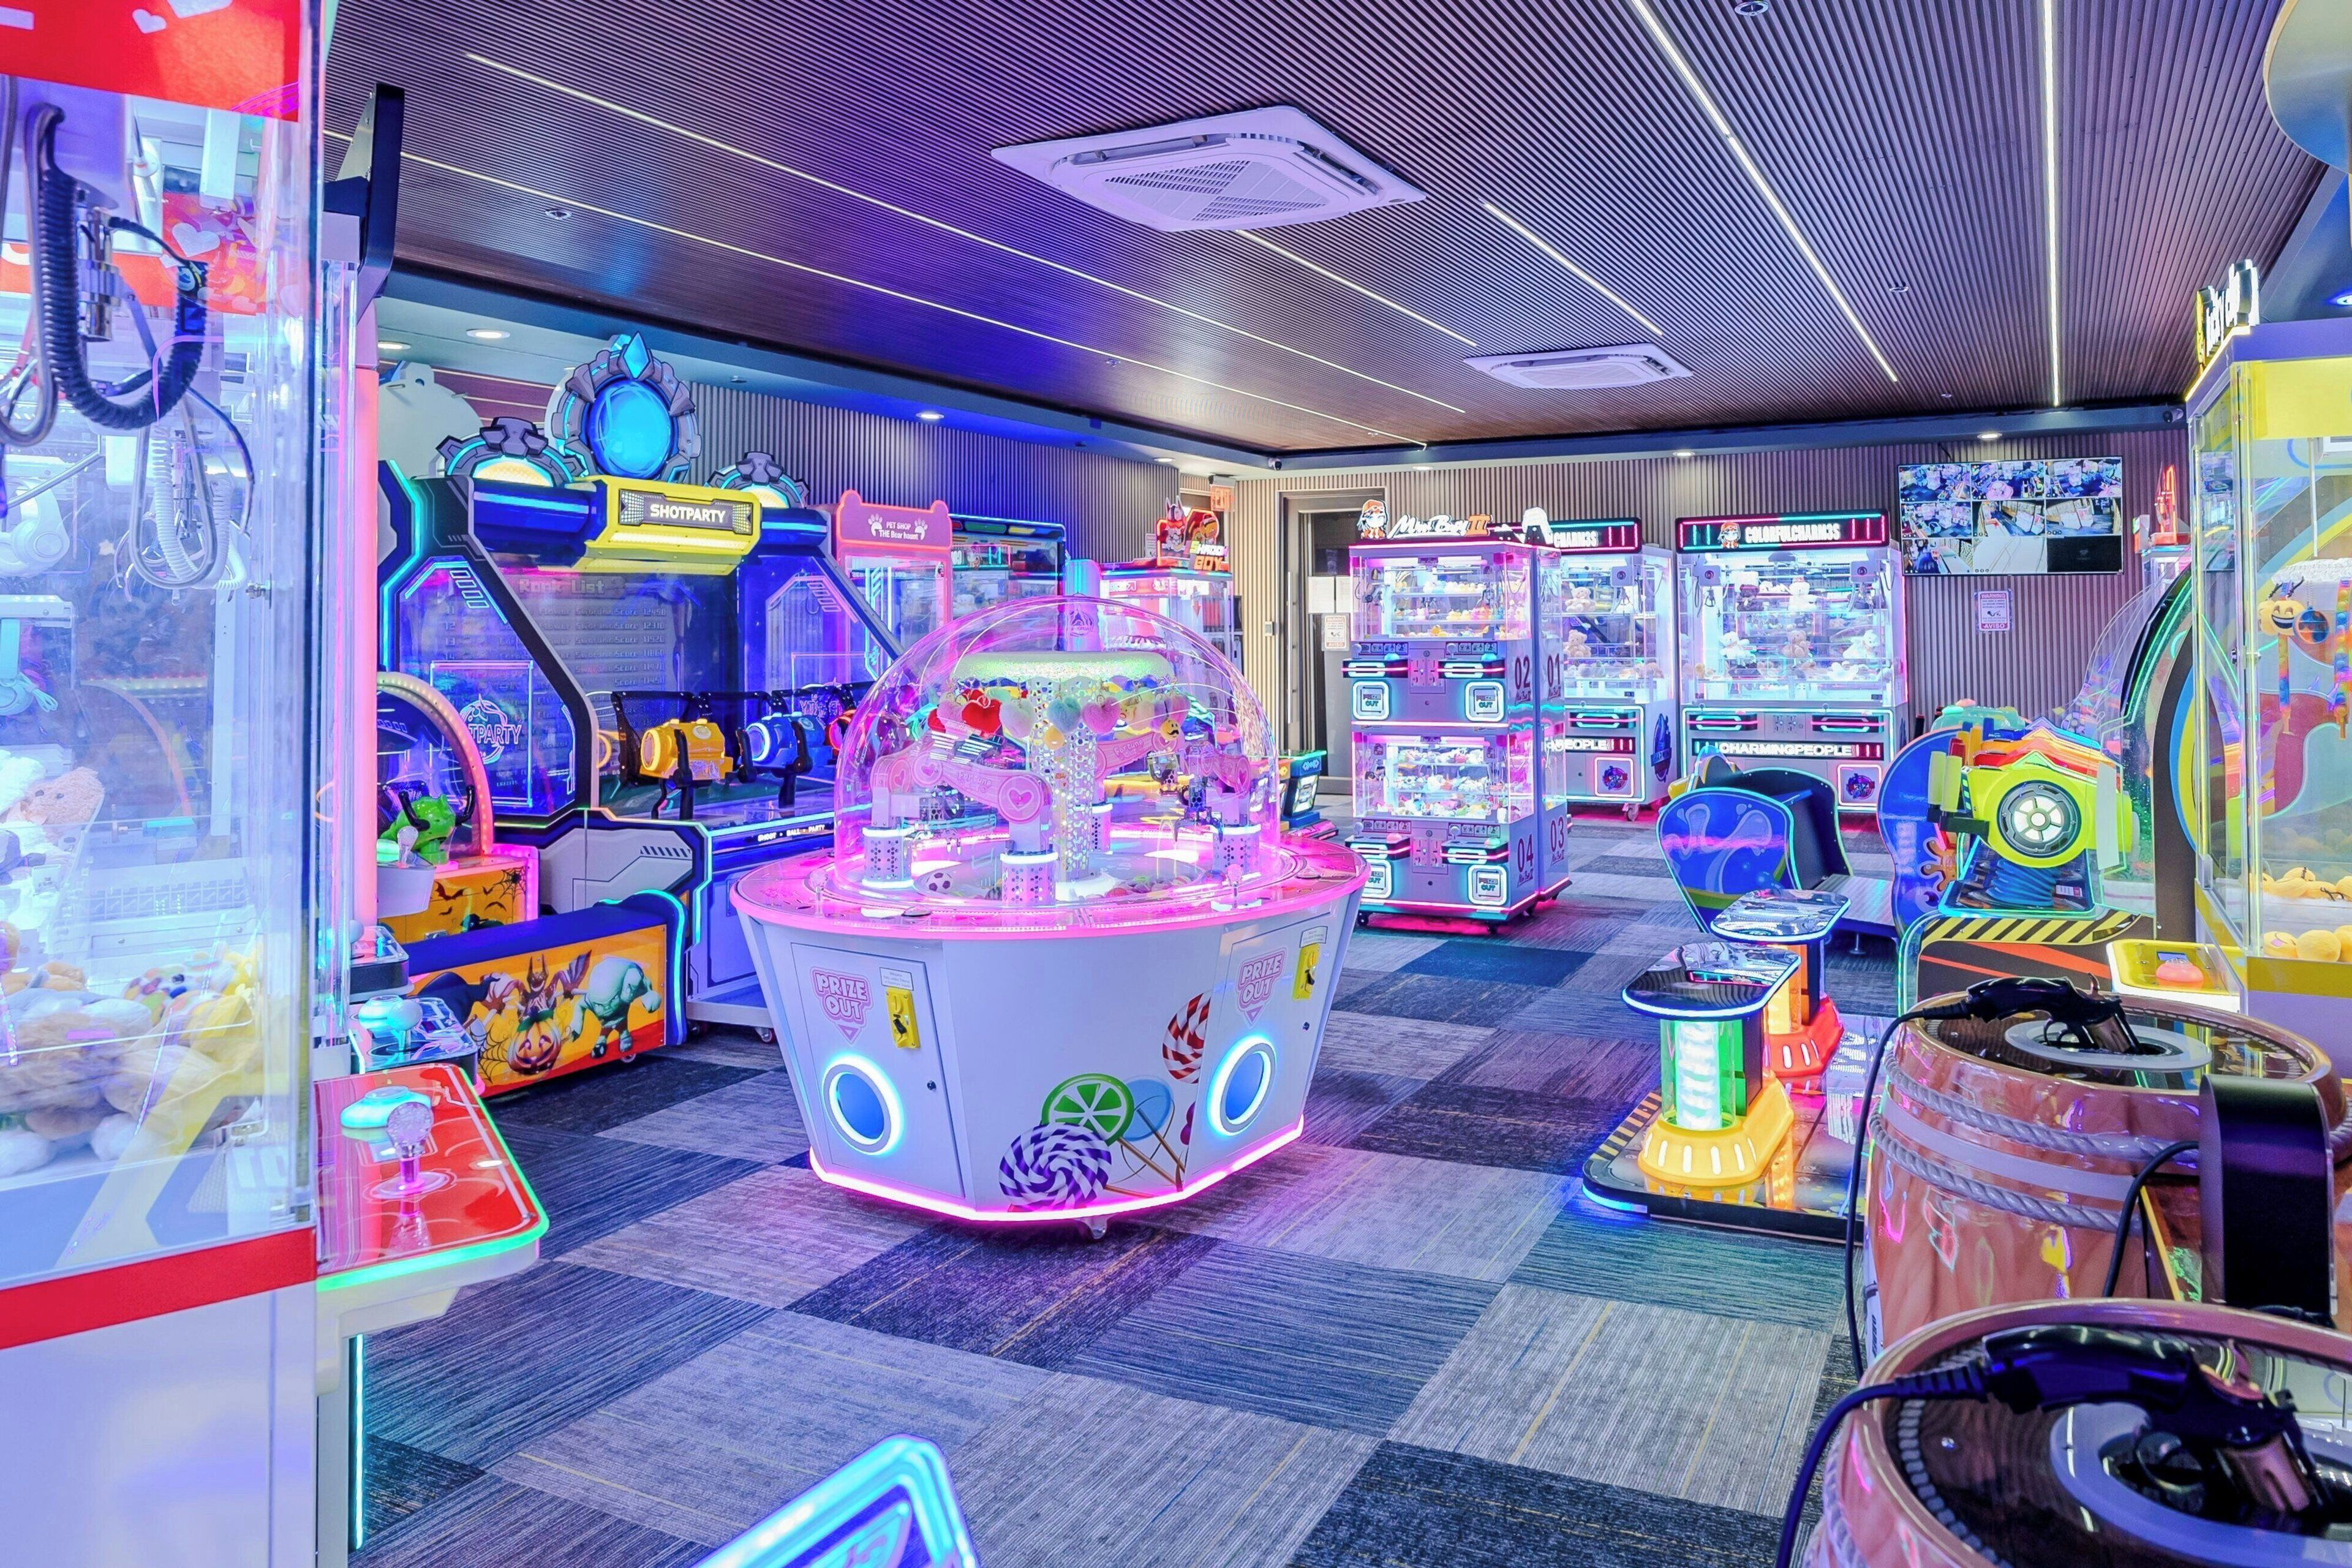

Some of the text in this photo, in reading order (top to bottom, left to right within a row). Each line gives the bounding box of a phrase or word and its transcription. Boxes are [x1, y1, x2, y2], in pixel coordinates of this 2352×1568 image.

[650, 503, 726, 523] SHOTPARTY
[1465, 514, 1491, 536] II
[879, 529, 890, 538] THE
[1194, 555, 1223, 571] BOY
[571, 579, 605, 594] List
[1515, 655, 1531, 690] 02
[1547, 653, 1560, 687] 01
[1719, 742, 1853, 756] CHARMINGPEOPLE
[1550, 816, 1564, 852] 03
[1517, 834, 1534, 872] 04
[1240, 953, 1283, 986] PRIZE
[815, 973, 868, 1001] PRIZE
[1242, 976, 1274, 1004] OUT
[825, 995, 861, 1020] OUT
